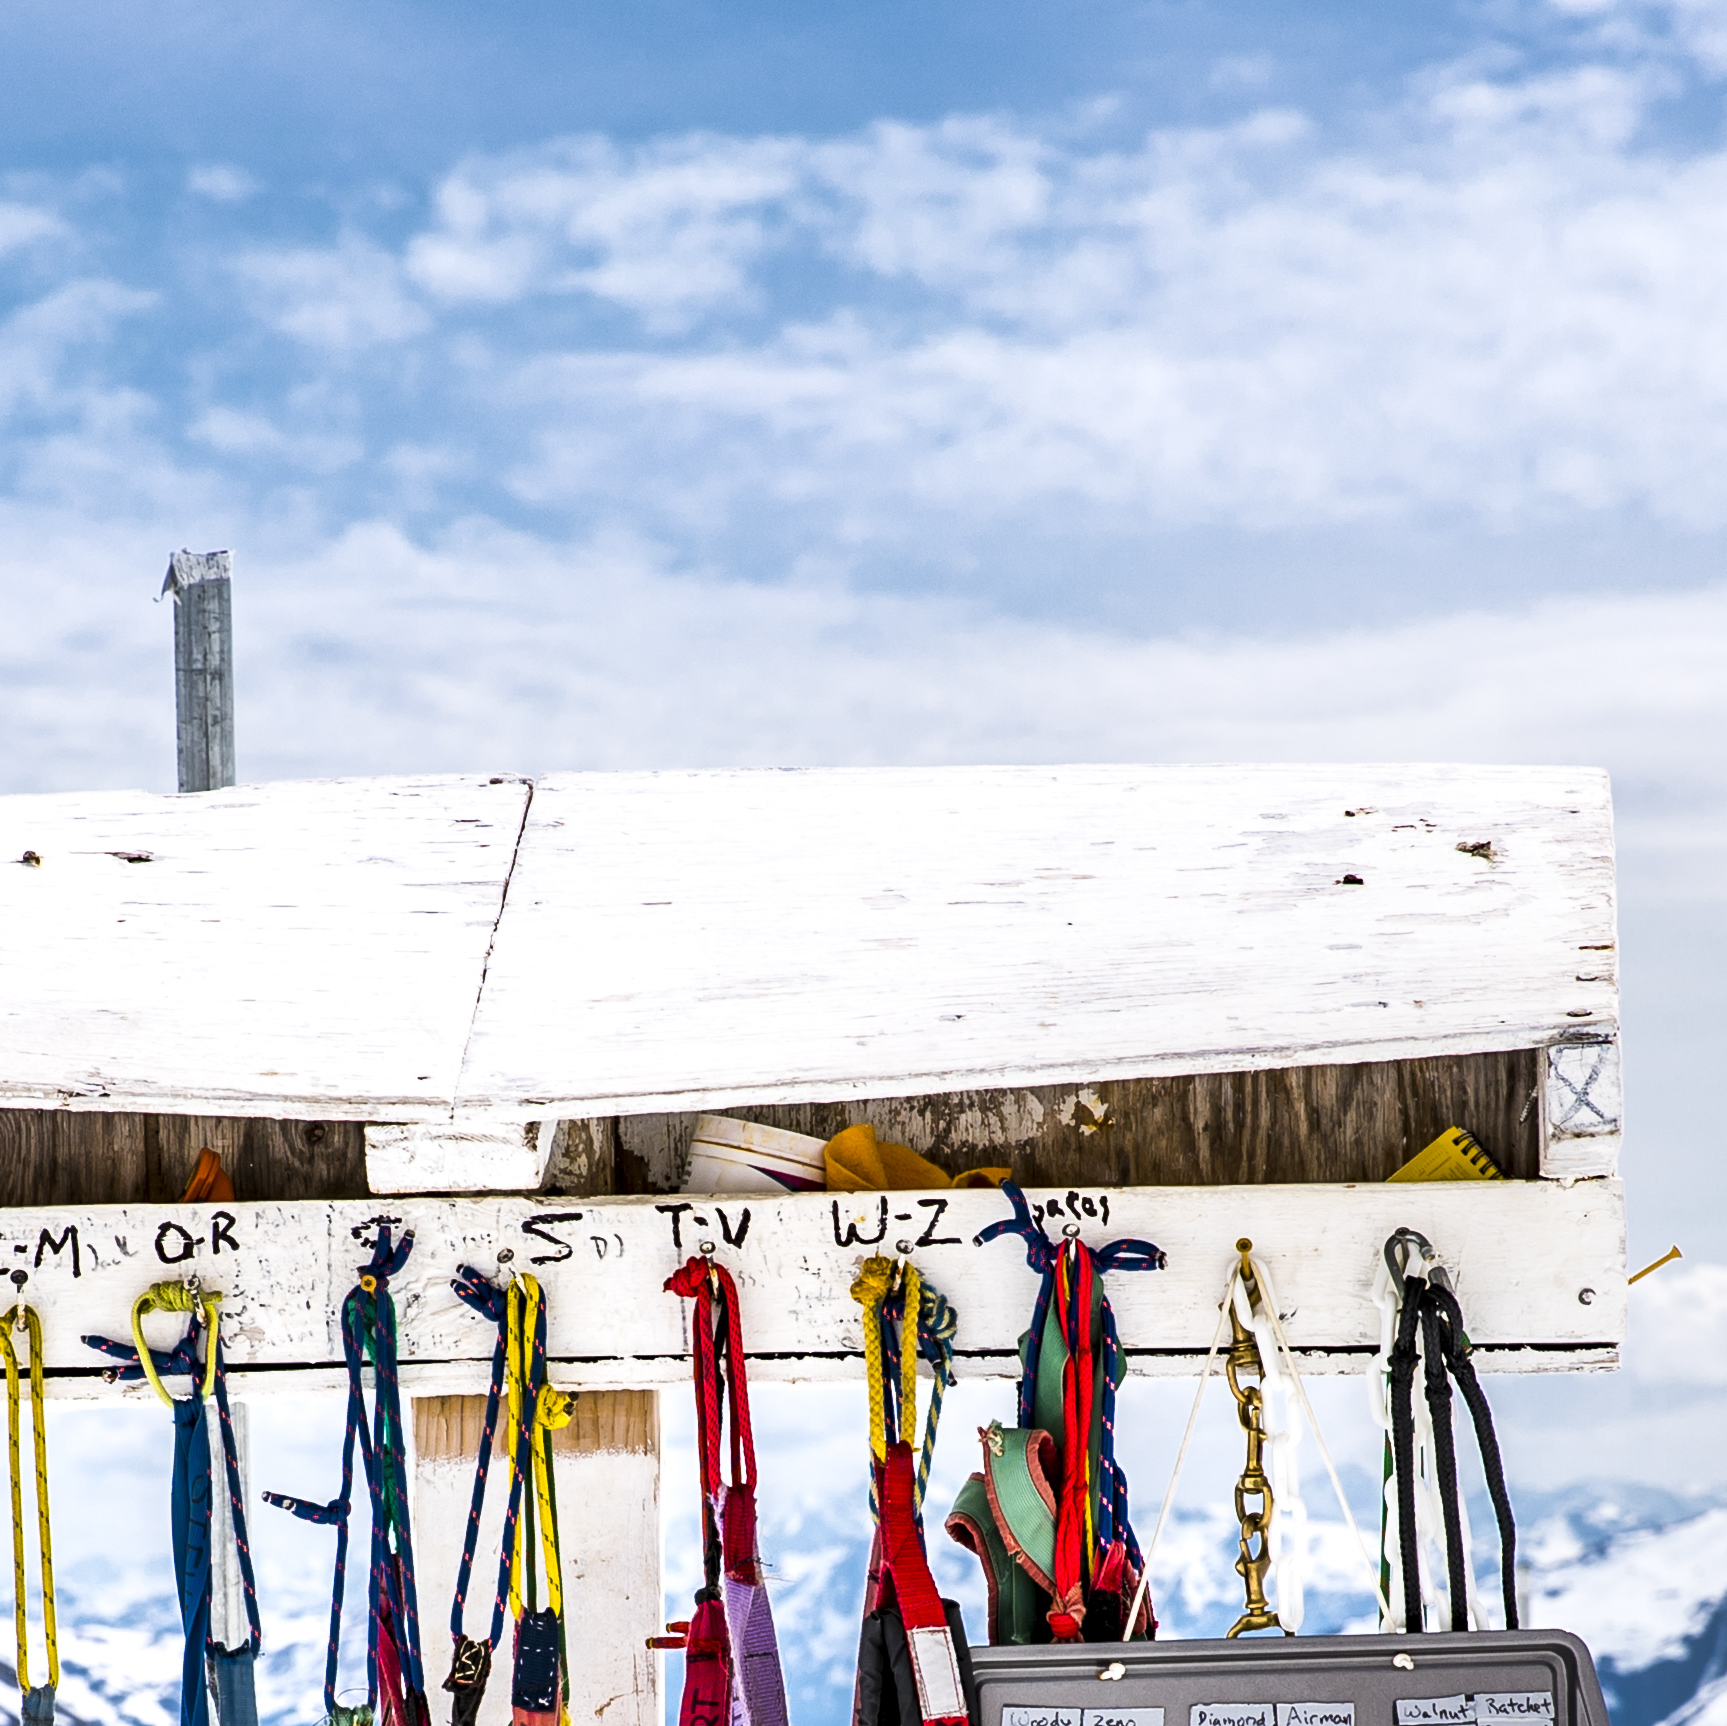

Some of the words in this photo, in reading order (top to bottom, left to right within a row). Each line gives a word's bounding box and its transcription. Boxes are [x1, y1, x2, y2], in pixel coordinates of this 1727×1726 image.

[521, 1212, 583, 1266] S
[654, 1202, 751, 1250] T-V
[831, 1195, 962, 1250] W-Z
[1286, 1706, 1353, 1726] Airman
[1404, 1702, 1471, 1721] Walnut
[1485, 1695, 1552, 1716] Ratchet
